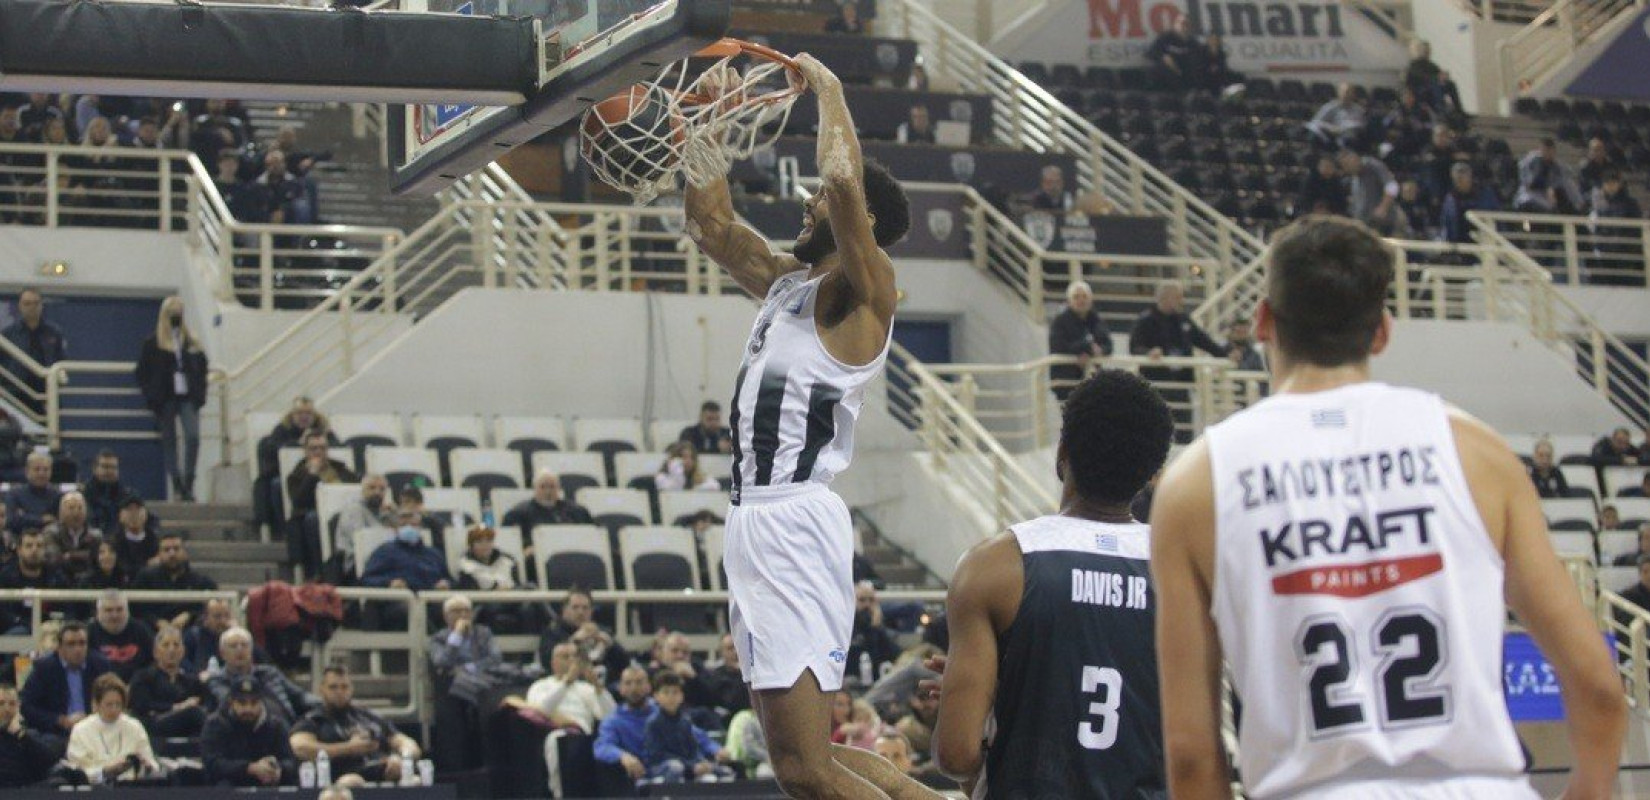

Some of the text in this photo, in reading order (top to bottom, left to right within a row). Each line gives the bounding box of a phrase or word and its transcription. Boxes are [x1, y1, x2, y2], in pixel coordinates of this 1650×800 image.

[1087, 0, 1345, 39] Molinari
[1259, 506, 1435, 567] KRAFT
[1071, 568, 1147, 610] DAVIS JR
[1310, 563, 1400, 590] PAINTS
[1294, 604, 1453, 741] 22
[1077, 665, 1123, 750] 3
